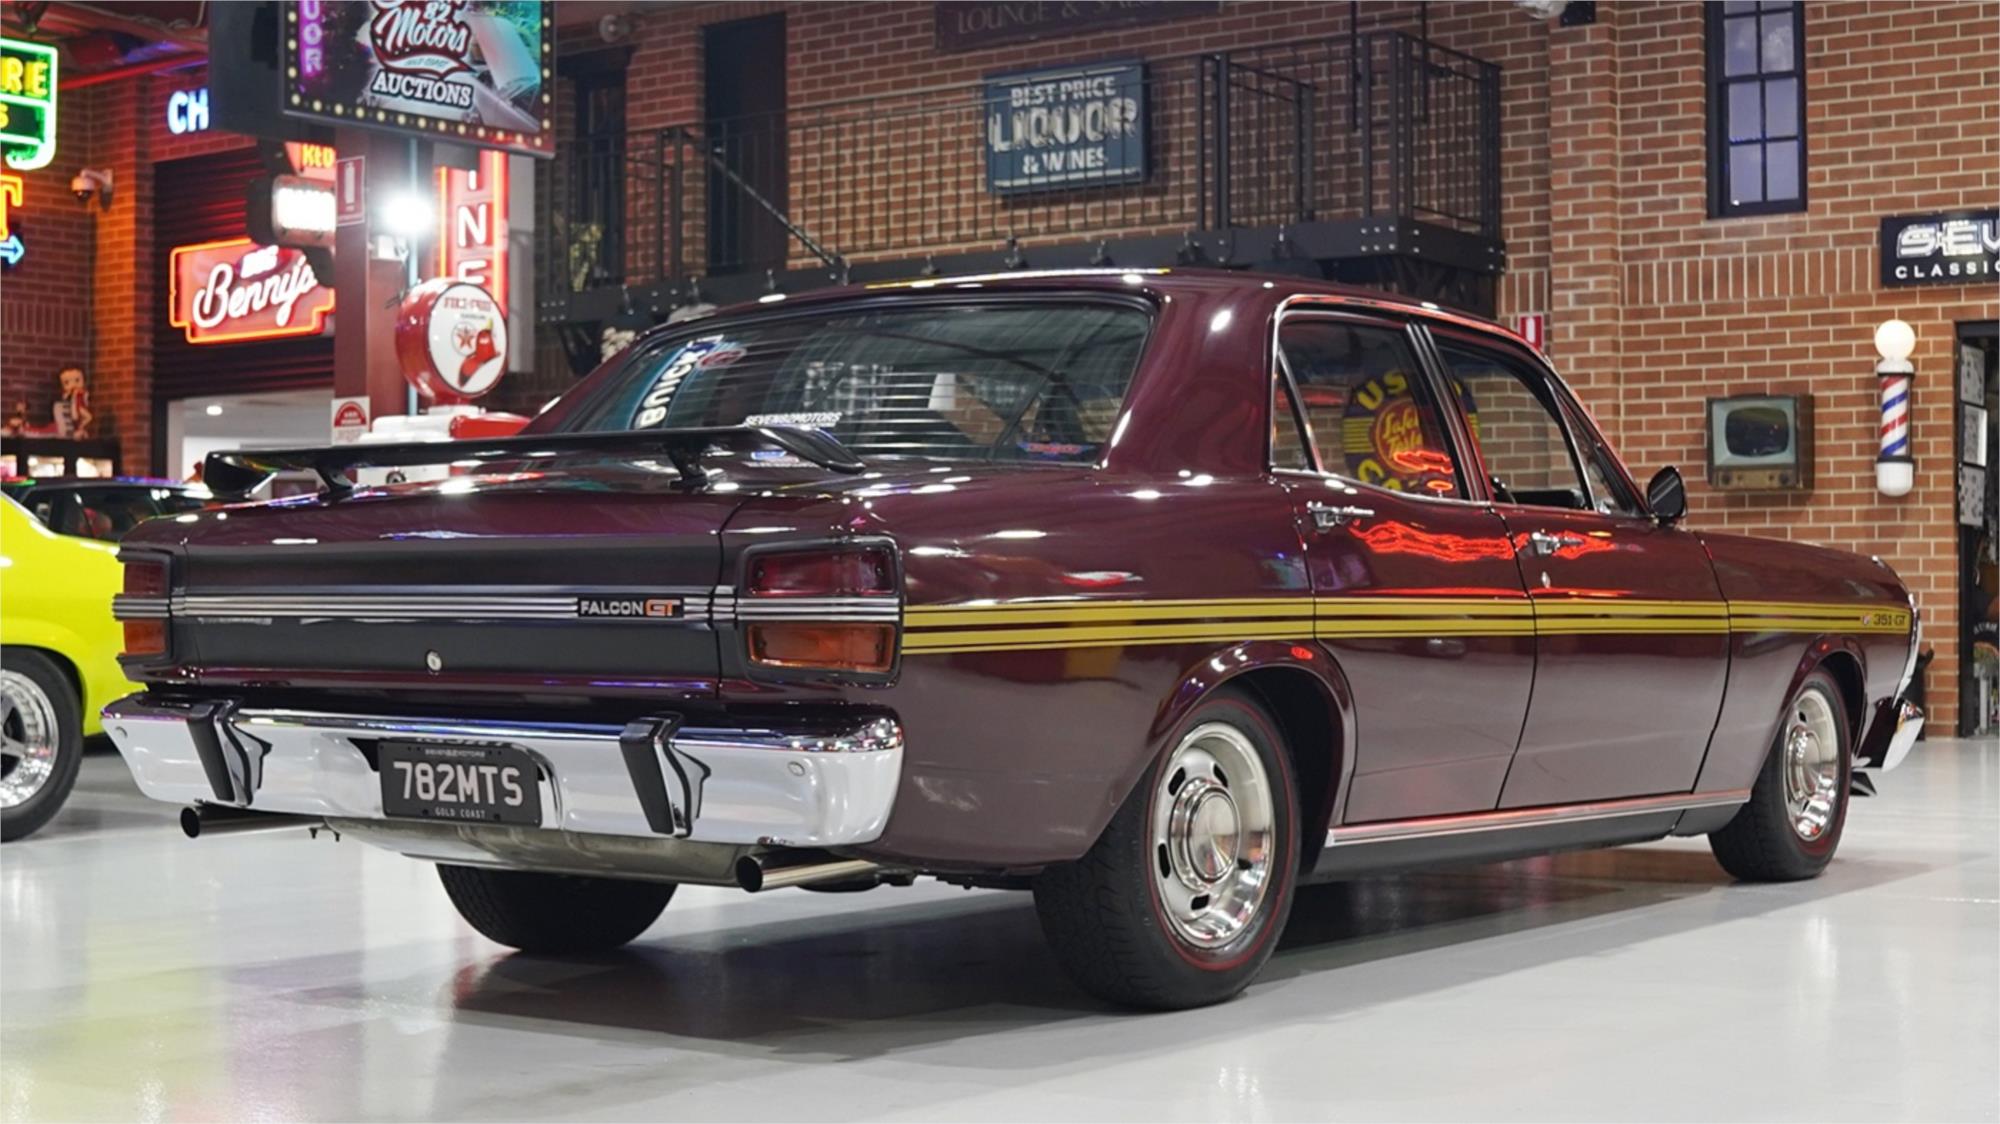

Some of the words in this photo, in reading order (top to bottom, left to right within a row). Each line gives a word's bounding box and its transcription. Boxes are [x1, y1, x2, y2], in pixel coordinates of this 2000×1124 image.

[423, 1, 451, 22] 82
[957, 2, 1051, 35] LOUNGE
[374, 7, 469, 53] Motors
[371, 70, 473, 107] AUCTIONS
[1011, 83, 1056, 108] BEST
[1060, 76, 1117, 101] PRICE
[988, 97, 1138, 152] LIQUOR
[1022, 155, 1039, 175] &
[192, 254, 319, 328] Benny's
[580, 600, 644, 616] FALCON
[644, 598, 681, 617] GT
[392, 761, 524, 807] 782MTS
[435, 806, 456, 817] GOLD
[460, 807, 486, 819] COAST
